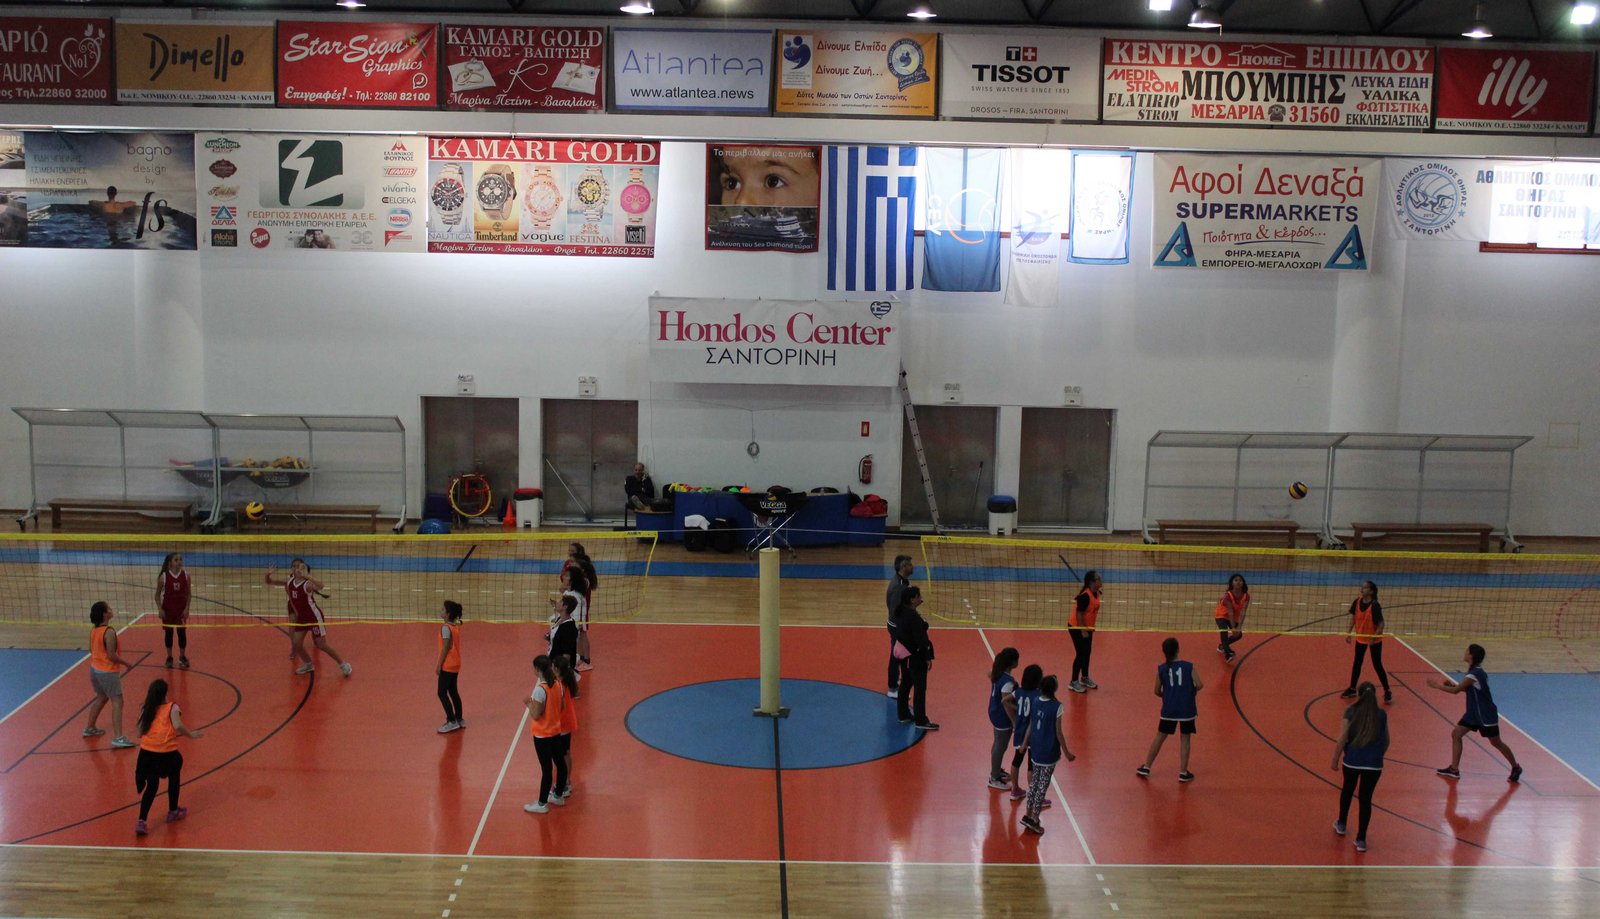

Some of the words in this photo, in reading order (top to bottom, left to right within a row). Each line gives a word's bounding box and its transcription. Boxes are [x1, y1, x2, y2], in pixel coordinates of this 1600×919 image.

[446, 27, 535, 47] KAMARI
[541, 29, 602, 49] GOLD
[459, 46, 511, 58] ΓΑΜΟΣ
[523, 47, 591, 60] ΒΑΠΤΙΣΗ
[816, 40, 851, 52] Δίνουμε
[854, 40, 887, 52] Ελπίδα
[142, 32, 244, 82] Dimello
[1111, 41, 1222, 67] ΚΕΝΤΡΟ
[1241, 55, 1282, 66] HOME
[1305, 46, 1430, 71] ΕΠΙΠΛΟΥ
[361, 59, 423, 78] Graphics
[622, 49, 764, 76] Atlantea
[0, 63, 63, 83] AURANT
[815, 64, 849, 77] Δίνουμε
[971, 64, 1070, 84] TISSOT
[1107, 69, 1161, 81] MEDIA
[1126, 80, 1179, 93] STROM
[1181, 70, 1346, 104] ΜΠΟΥΜΠΗΣ
[1351, 76, 1394, 89] ΛΕΥΚΑ
[1398, 77, 1429, 90] ΕΙΔΗ
[1478, 56, 1548, 118] illy
[75, 89, 107, 100] 32000
[285, 86, 347, 102] Επιγραφές!
[374, 91, 397, 101] 22860
[399, 91, 431, 101] 82100
[630, 87, 754, 100] www.atlantea.news
[1107, 93, 1180, 108] ELATIRIO
[1362, 90, 1420, 101] ΥΑΛΙΚΑ
[970, 106, 1001, 115] DROSOS
[1029, 108, 1069, 117] SANTORINI
[1191, 104, 1265, 121] ΜΕΣΑΡΙΑ
[1289, 105, 1341, 124] 31560
[1356, 101, 1429, 114] ΦΩΤΙΣΤΙΚΑ
[1137, 109, 1179, 121] STROM
[1345, 113, 1429, 127] ΕΚΚΛΗΣΙΑΣΤΙΚΑ
[127, 143, 173, 162] bagno
[431, 138, 558, 162] KAMARI
[567, 141, 657, 164] GOLD
[713, 148, 724, 157] Το
[133, 162, 167, 176] design
[145, 175, 155, 185] by
[1169, 163, 1243, 200] Αφοί
[1253, 166, 1364, 204] Δεναξά
[1475, 169, 1550, 186] ΑΘΛΗΤΙΚΟΣ
[1396, 164, 1425, 207] ΑΘΛΗΤΙΚΟΣ
[1427, 162, 1458, 179] ΟΜΙΛΟΣ
[1456, 178, 1468, 208] ΘΗΡΑΣ
[1516, 188, 1566, 203] ΘΗΡΑΣ
[247, 210, 291, 220] ΓΕΩΡΓΙΟΣ
[293, 211, 347, 221] ΣΥΝΟΛΑΚΗΣ
[1175, 202, 1359, 222] SUPERMARKETS
[1498, 204, 1577, 219] ΣΑΝΤΟΡΙΝΗ
[257, 220, 294, 228] ΑΝΩΝΥΜΗ
[296, 220, 334, 228] ΕΜΠΟΡΙΚΗ
[335, 220, 368, 229] ΕΤΑΙΡΕΙΑ
[1403, 218, 1457, 236] ΣΑΝΤΟΡΙΝΗ
[428, 232, 472, 241] NAUTICA
[474, 231, 518, 242] Timberland
[521, 233, 564, 242] vogue
[569, 235, 611, 244] FESTINA
[1202, 229, 1252, 244] Ποιότητα
[1255, 224, 1270, 240] &
[602, 246, 629, 256] 22860
[754, 241, 765, 249] Sea
[766, 241, 793, 250] Diamond
[1224, 249, 1301, 259] ΦΗΡΑ-ΜΕΣΑΡΙΑ
[1201, 259, 1322, 270] ΕΜΠΟΡΕΙΟ-ΜΕΓΑΛΟΧΩΡΙ
[656, 310, 776, 344] Hondos
[786, 311, 892, 346] Center
[706, 347, 836, 366] ΣΑΝΤΟΡΙΝΗ
[1168, 667, 1182, 687] 11
[1017, 696, 1031, 717] 10
